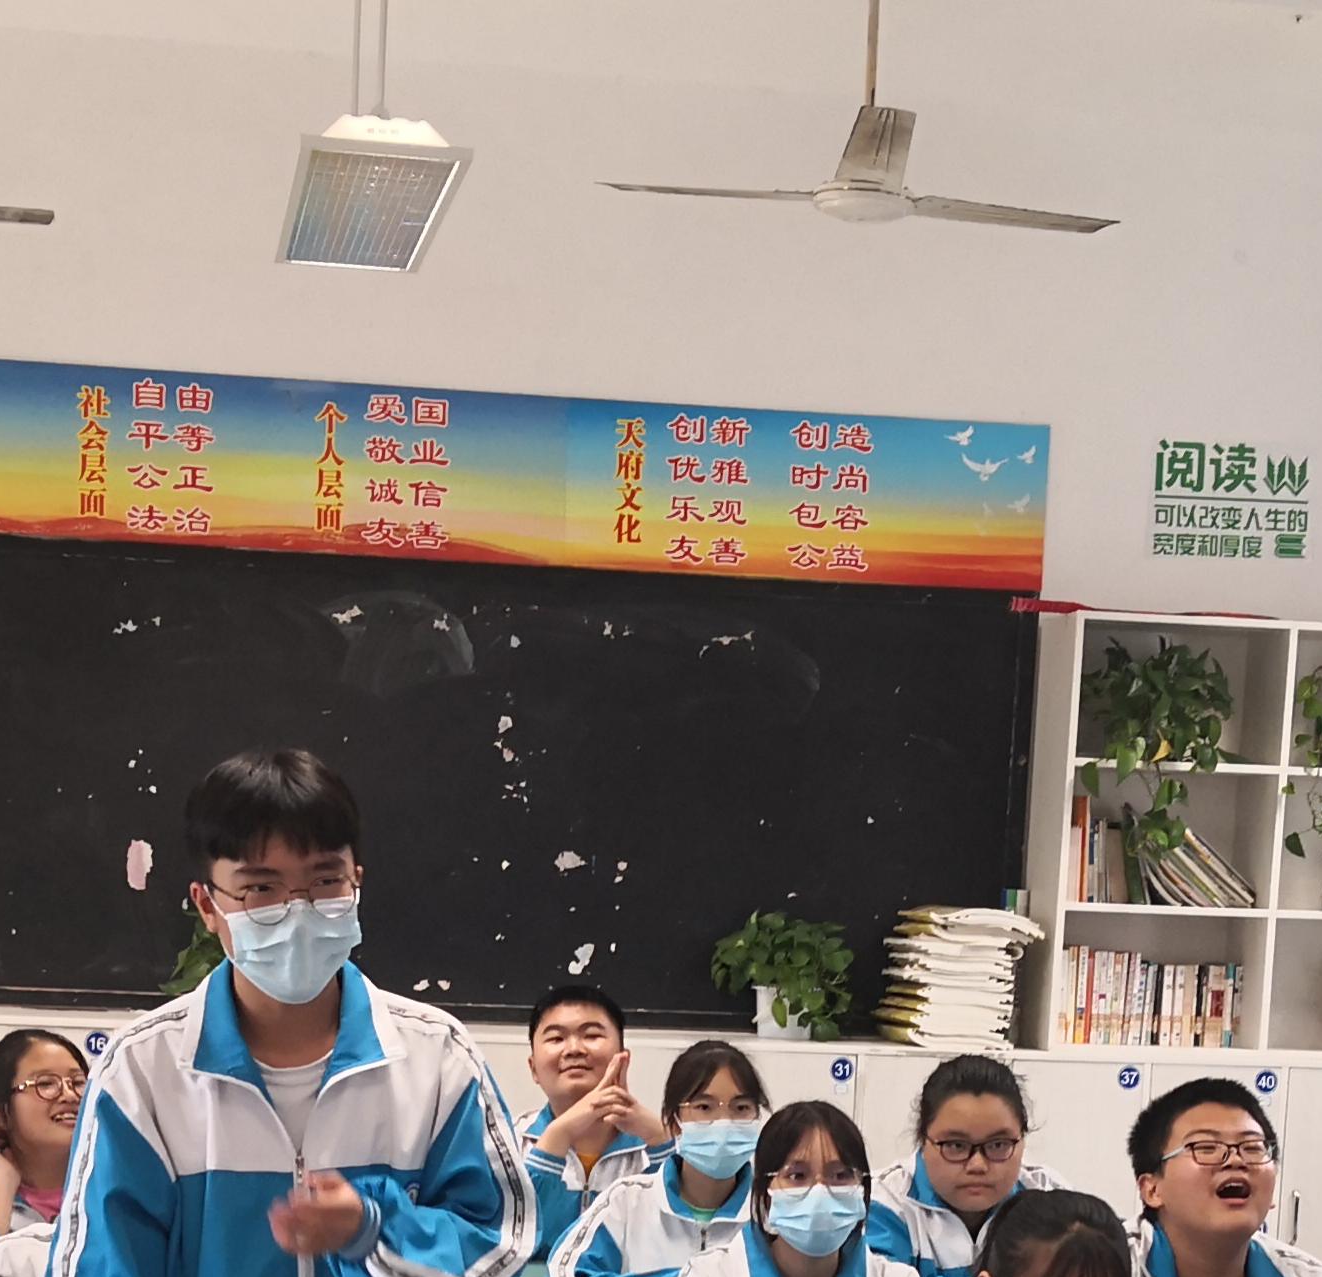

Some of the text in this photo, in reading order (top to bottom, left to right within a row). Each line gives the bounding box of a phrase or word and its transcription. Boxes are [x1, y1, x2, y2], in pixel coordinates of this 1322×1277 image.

[131, 379, 213, 413] 自由
[365, 395, 449, 429] 爱国
[128, 420, 216, 452] 平等
[666, 413, 752, 450] 创新
[789, 420, 873, 454] 创造
[77, 385, 110, 519] 社会层面
[315, 403, 347, 534] 个人层面
[364, 436, 450, 469] 敬业
[1155, 439, 1256, 495] 阅读
[127, 461, 214, 494] 公正
[613, 417, 646, 545] 天府文化
[664, 452, 750, 488] 优雅
[789, 462, 871, 497] 时尚
[363, 477, 448, 510] 诚信
[665, 493, 748, 527] 乐观
[126, 503, 212, 534] 法治
[361, 515, 449, 551] 友善
[788, 501, 869, 532] 包容
[1155, 502, 1308, 532] 可以改变人生的
[664, 533, 746, 567] 友善
[786, 542, 869, 574] 公益
[1153, 533, 1263, 558] 宽度和厚度
[89, 1036, 106, 1051] 16
[834, 1063, 851, 1078] 31
[1120, 1072, 1138, 1086] 37
[1257, 1075, 1276, 1089] 40
